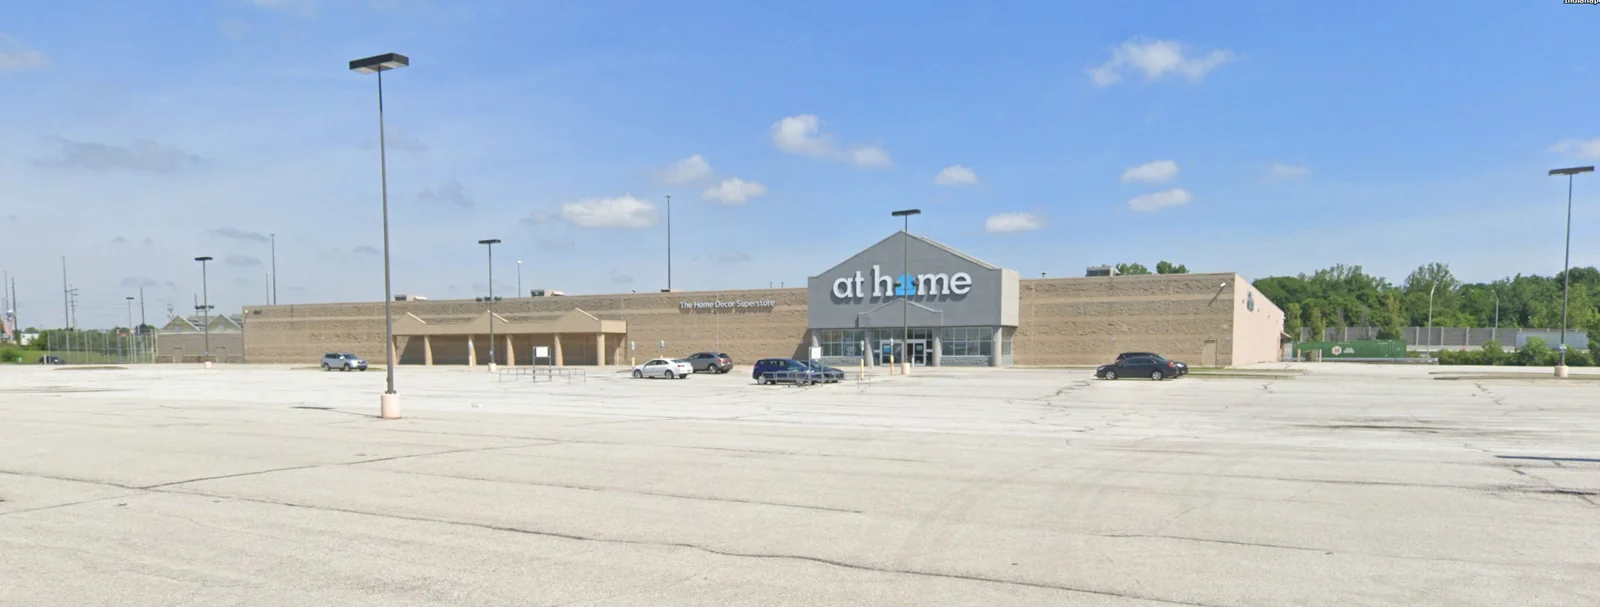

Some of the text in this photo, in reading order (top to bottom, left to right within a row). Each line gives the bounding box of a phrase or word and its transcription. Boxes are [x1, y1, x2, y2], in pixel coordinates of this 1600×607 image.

[833, 270, 865, 298] at
[680, 301, 692, 309] The
[694, 301, 713, 309] Home
[736, 300, 775, 309] Superstore
